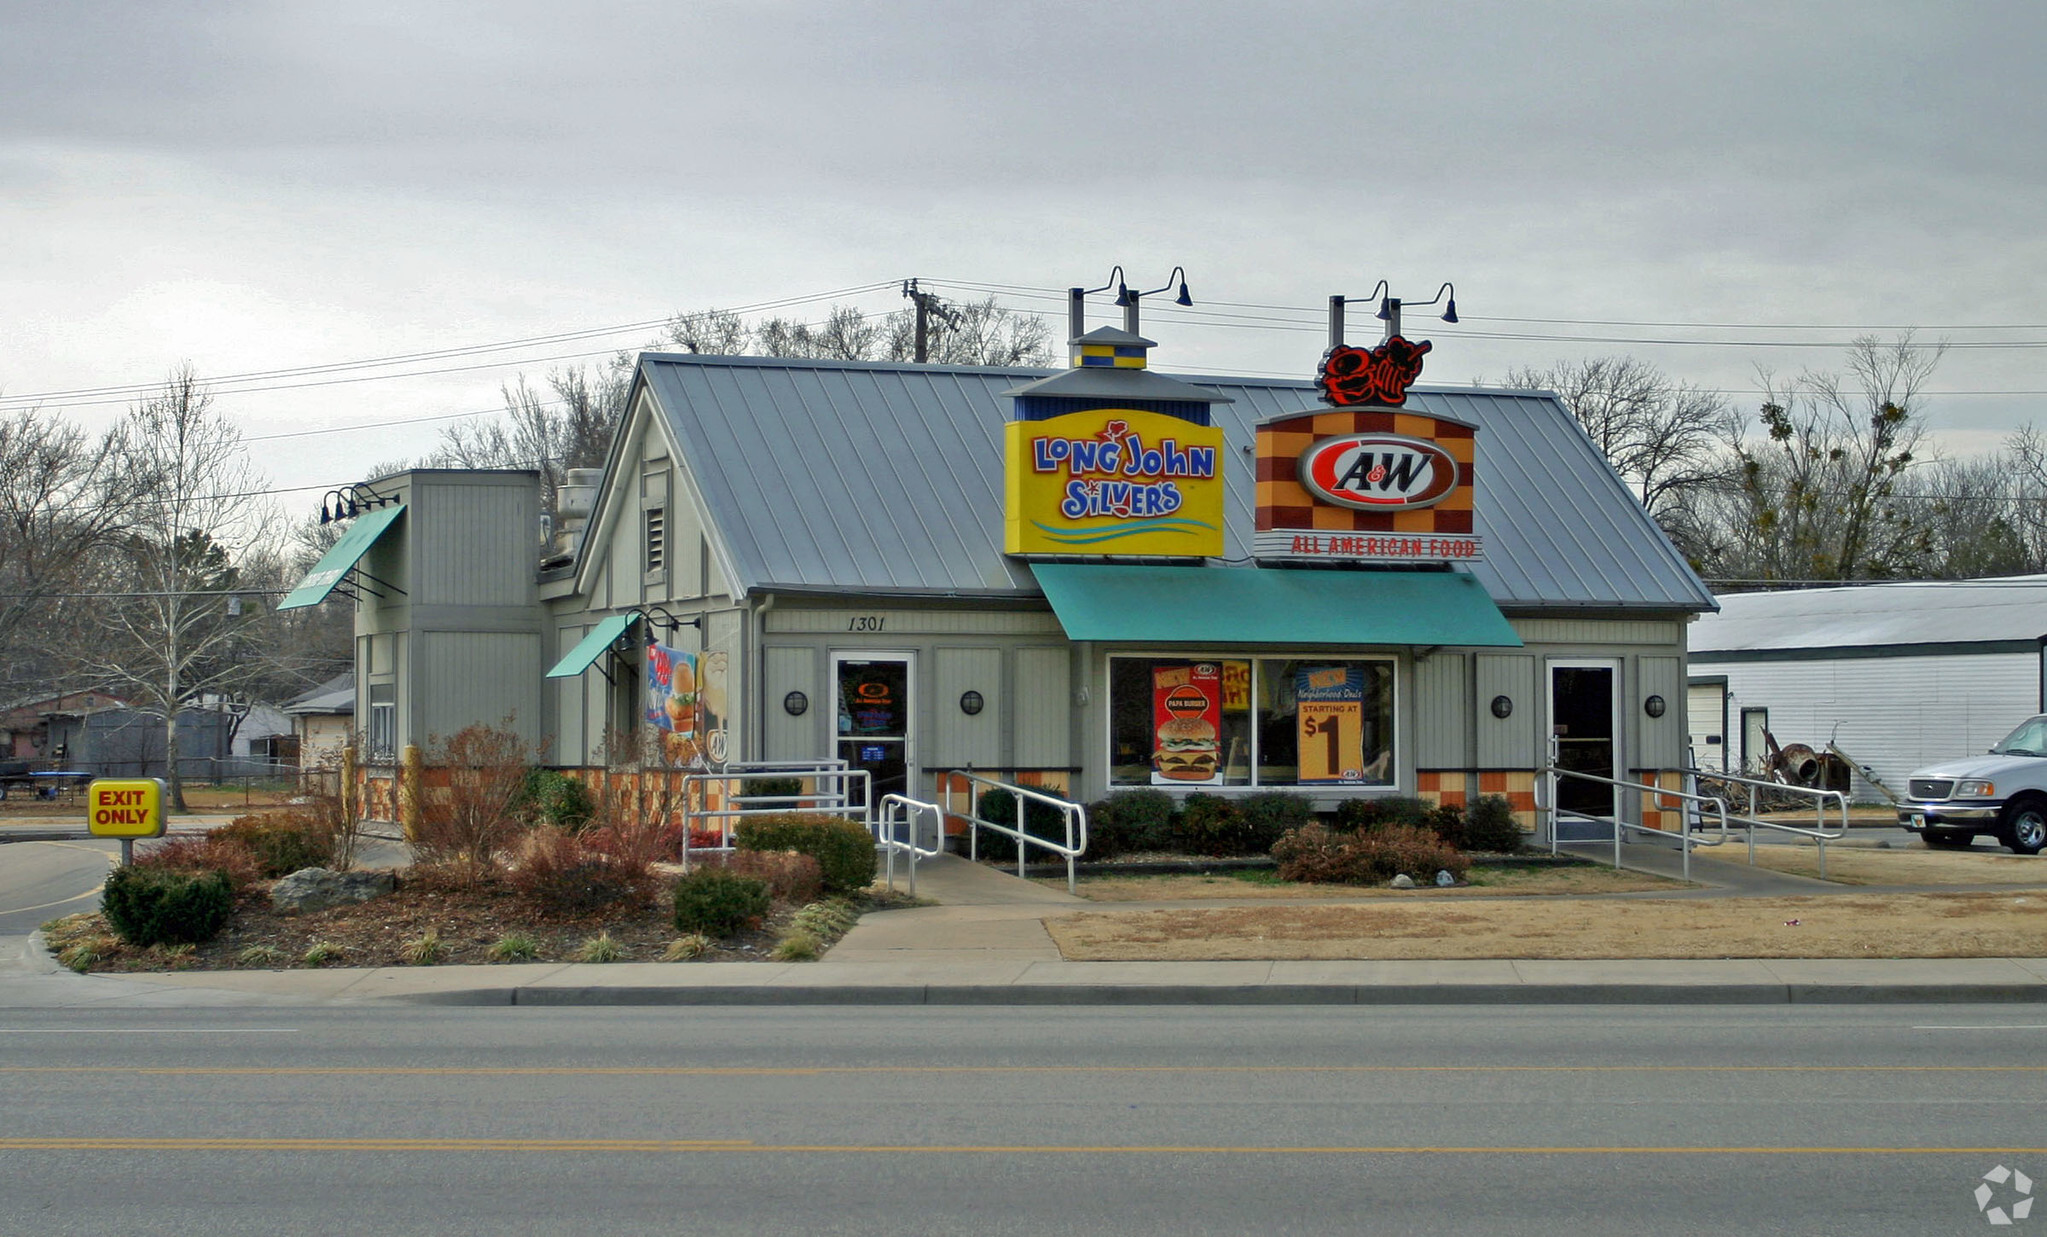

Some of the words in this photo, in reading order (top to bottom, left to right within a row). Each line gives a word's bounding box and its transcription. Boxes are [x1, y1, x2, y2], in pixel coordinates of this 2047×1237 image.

[1332, 451, 1435, 493] A&W
[1290, 535, 1321, 554] ALL
[1328, 536, 1422, 557] AMERICAN
[1430, 539, 1475, 557] FOOD
[848, 616, 885, 631] 1301
[1303, 705, 1345, 713] STARTING
[1304, 715, 1339, 775] $1
[98, 791, 145, 806] EXIT
[95, 809, 149, 825] ONLY
